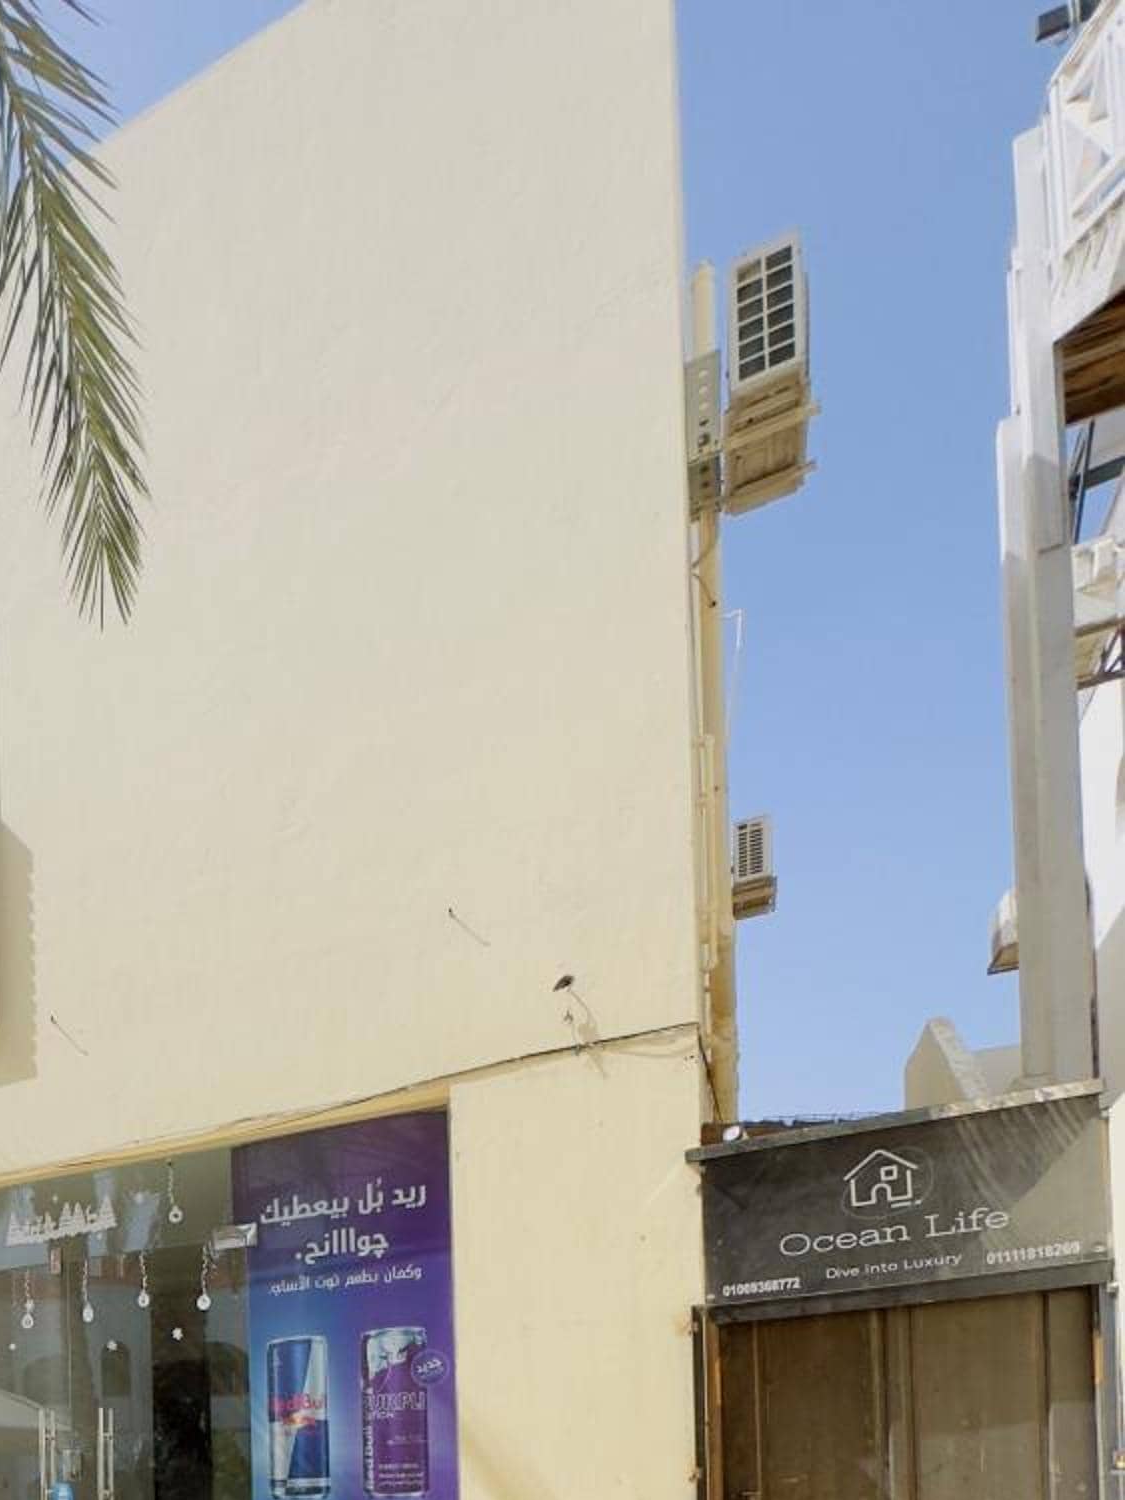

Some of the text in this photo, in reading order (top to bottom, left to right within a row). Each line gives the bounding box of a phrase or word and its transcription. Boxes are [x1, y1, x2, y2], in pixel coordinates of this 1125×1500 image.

[260, 1194, 349, 1226] بيعطيك
[392, 1184, 426, 1208] ريد
[779, 1207, 1009, 1257] Ocean Life
[826, 1253, 963, 1280] Dive into Luxury
